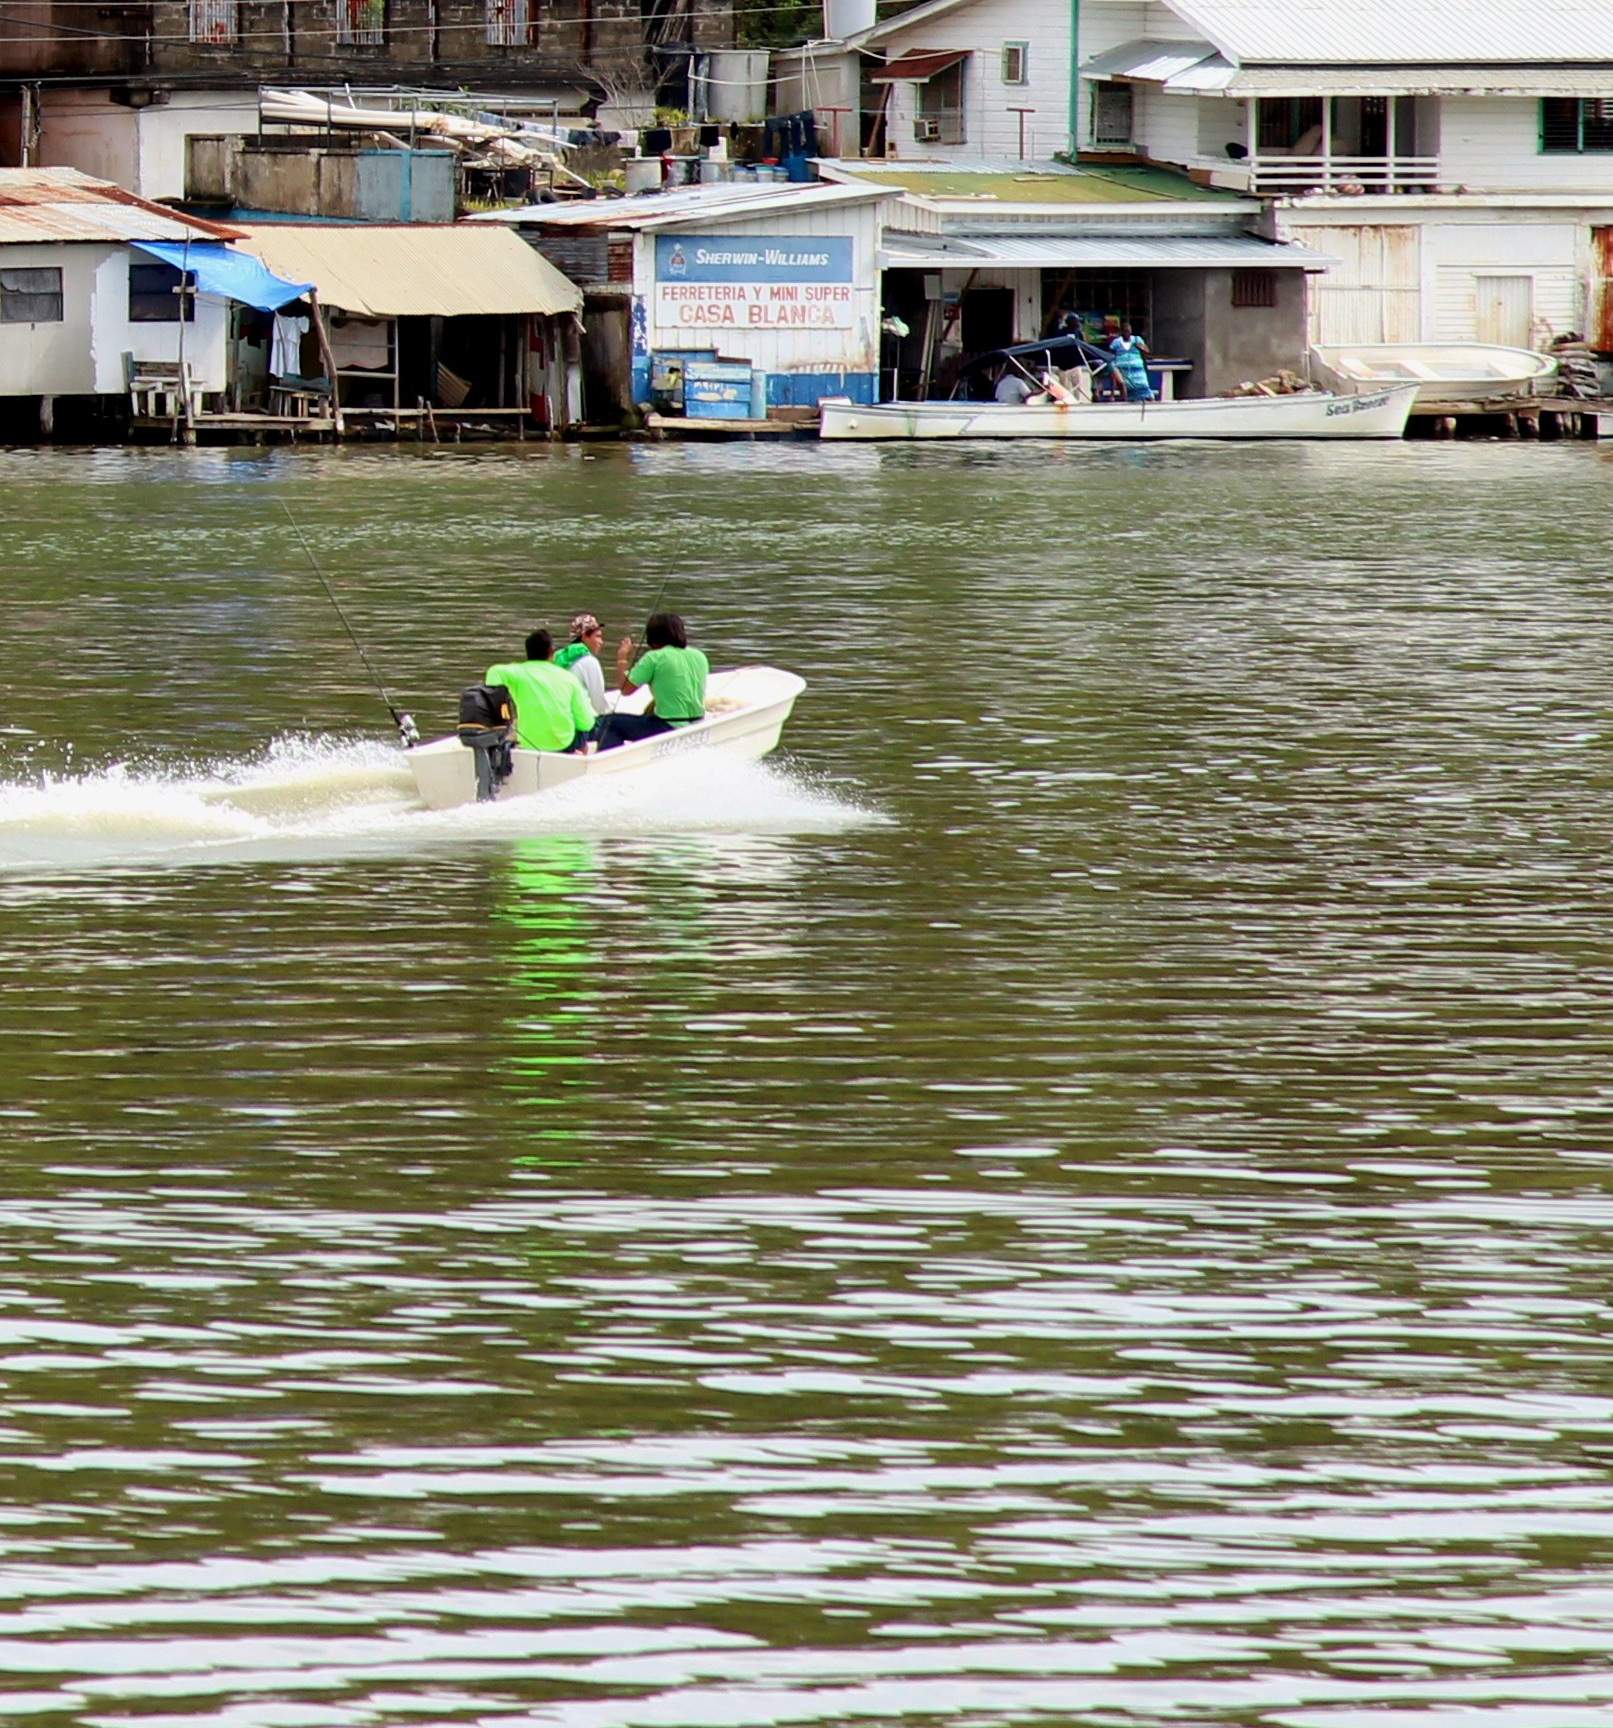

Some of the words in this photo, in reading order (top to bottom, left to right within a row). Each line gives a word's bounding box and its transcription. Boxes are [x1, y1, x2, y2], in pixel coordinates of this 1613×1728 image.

[662, 286, 746, 301] FERRETERIA
[753, 286, 763, 301] Y
[769, 286, 798, 301] MINI
[805, 286, 850, 301] SUPER
[679, 304, 735, 324] CASA
[748, 304, 835, 324] BLANCA
